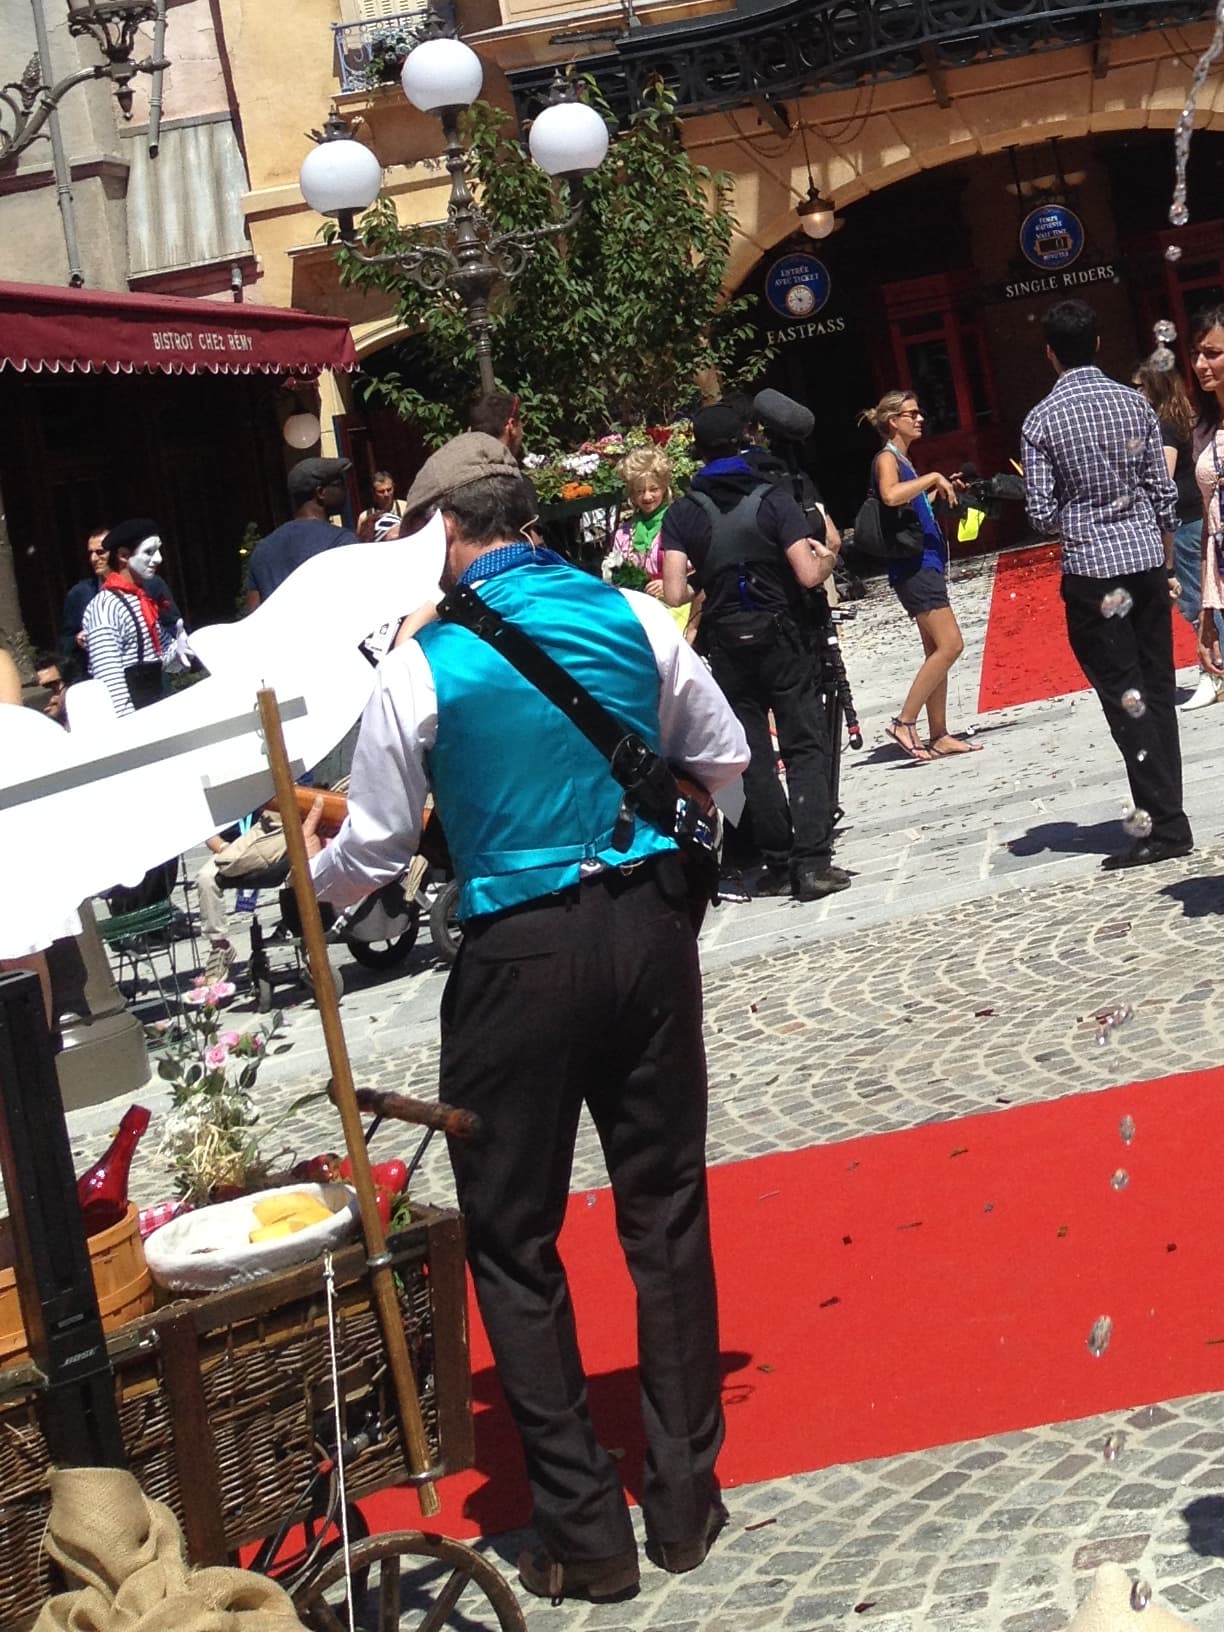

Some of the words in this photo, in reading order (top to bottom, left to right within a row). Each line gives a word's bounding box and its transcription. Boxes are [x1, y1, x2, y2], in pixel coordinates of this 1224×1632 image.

[1005, 276, 1058, 298] SINGLE
[1063, 265, 1114, 286] RIDERS
[152, 331, 194, 351] BISTROT
[198, 332, 226, 351] CHEZ
[227, 328, 253, 351] RÉMY
